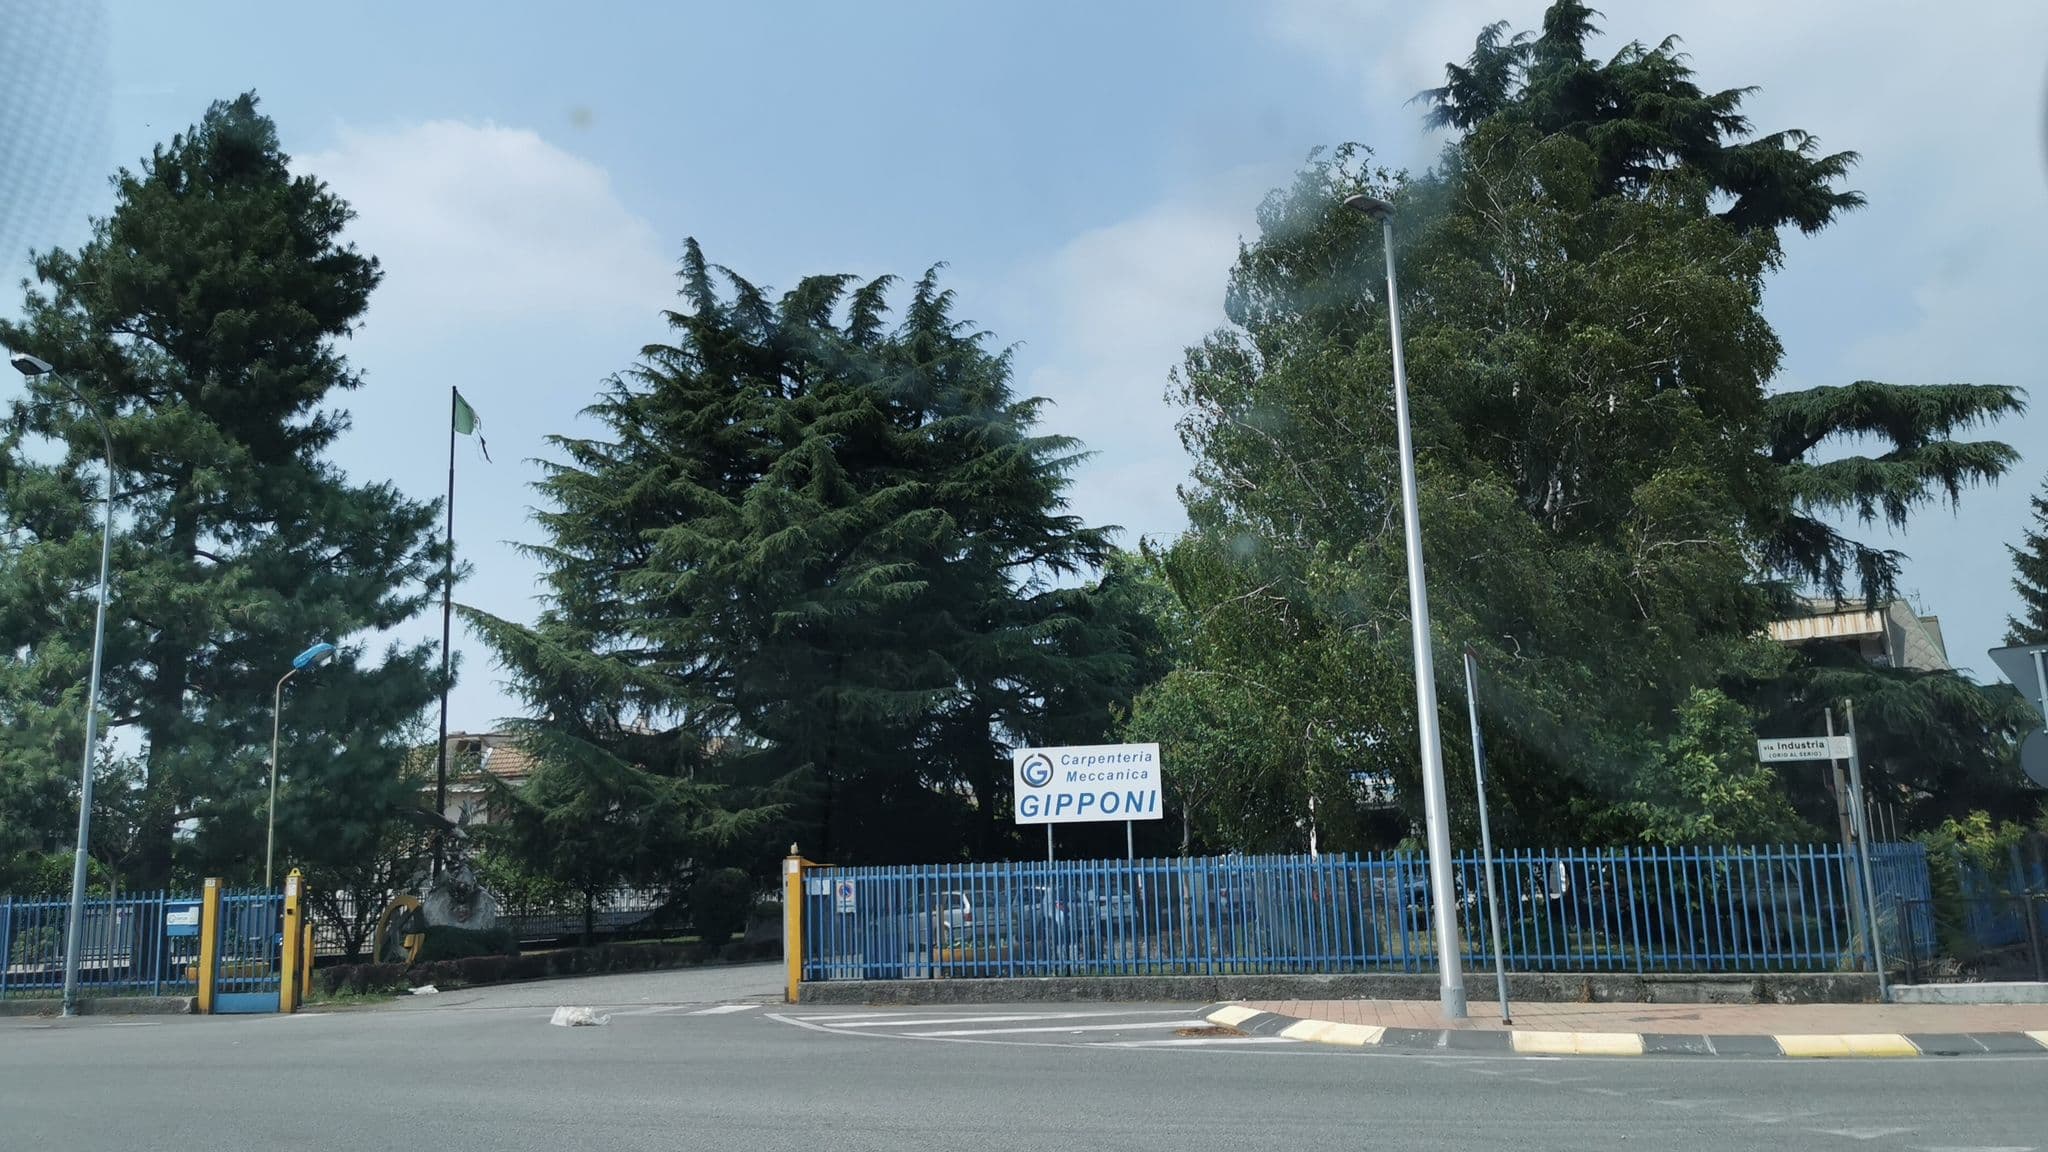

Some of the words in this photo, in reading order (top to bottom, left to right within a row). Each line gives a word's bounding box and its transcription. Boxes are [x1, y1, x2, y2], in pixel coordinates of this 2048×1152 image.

[1777, 741, 1825, 750] Industria
[1060, 751, 1152, 767] Carpenteria
[1066, 769, 1148, 782] Meccanica
[1020, 789, 1156, 818] GIPPONI
